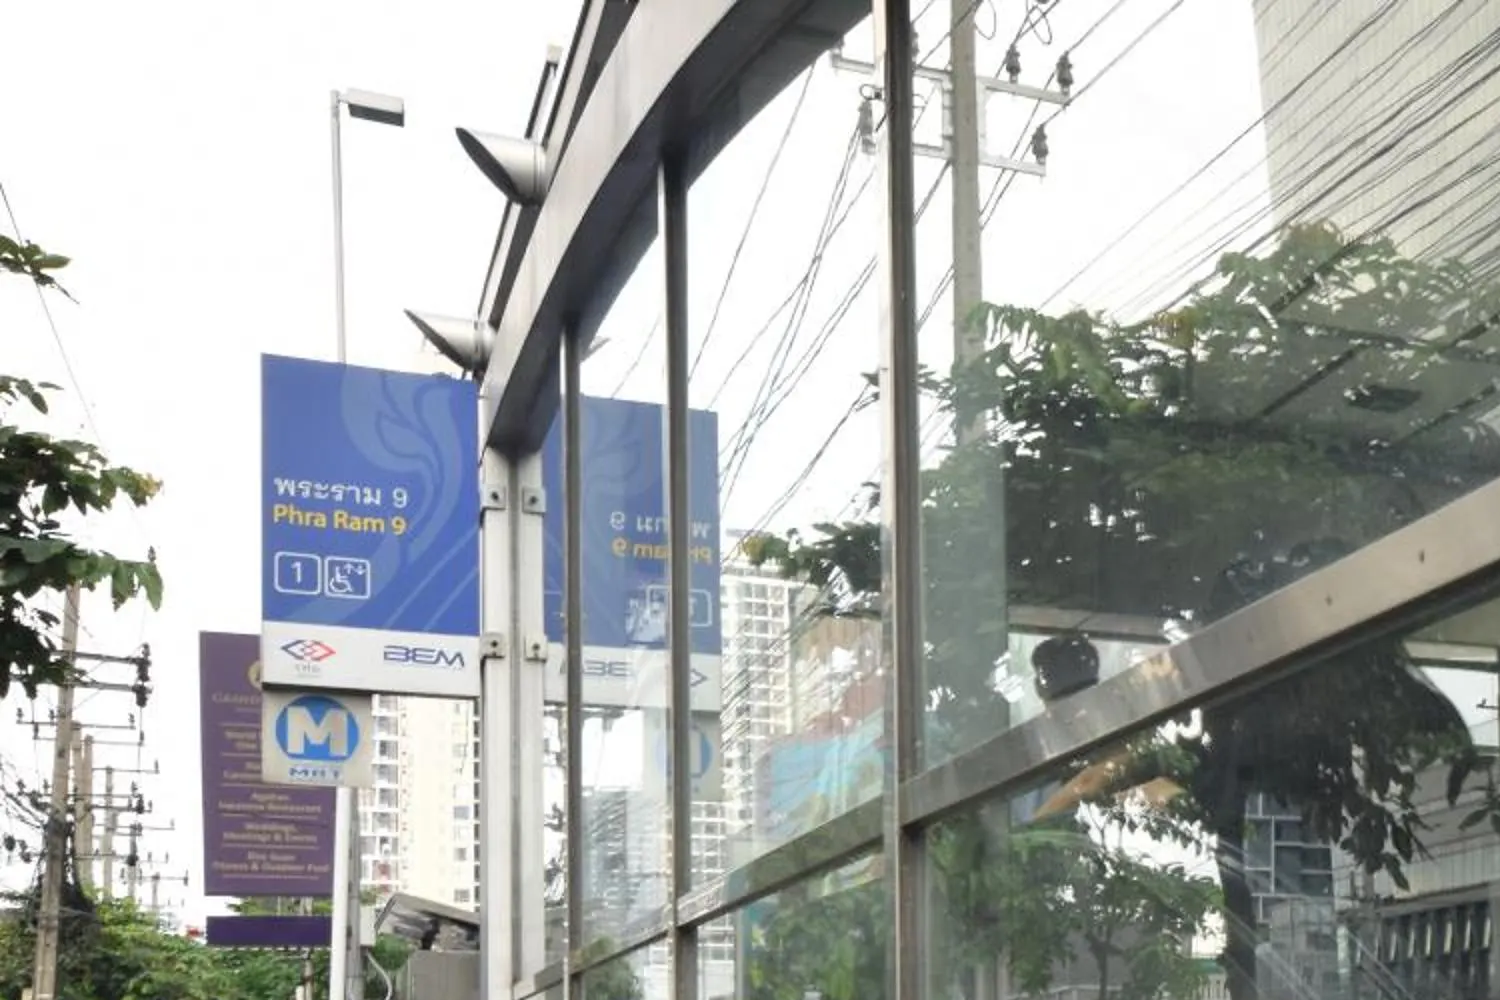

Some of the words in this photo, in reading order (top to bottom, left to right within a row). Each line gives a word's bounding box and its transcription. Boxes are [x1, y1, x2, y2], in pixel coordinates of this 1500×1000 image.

[274, 477, 381, 506] พระราม
[392, 487, 408, 508] 9
[273, 503, 327, 529] Phra
[334, 509, 385, 533] Ram
[391, 515, 407, 535] 9
[291, 561, 302, 583] 1
[383, 645, 465, 668] BEM
[286, 705, 349, 758] M
